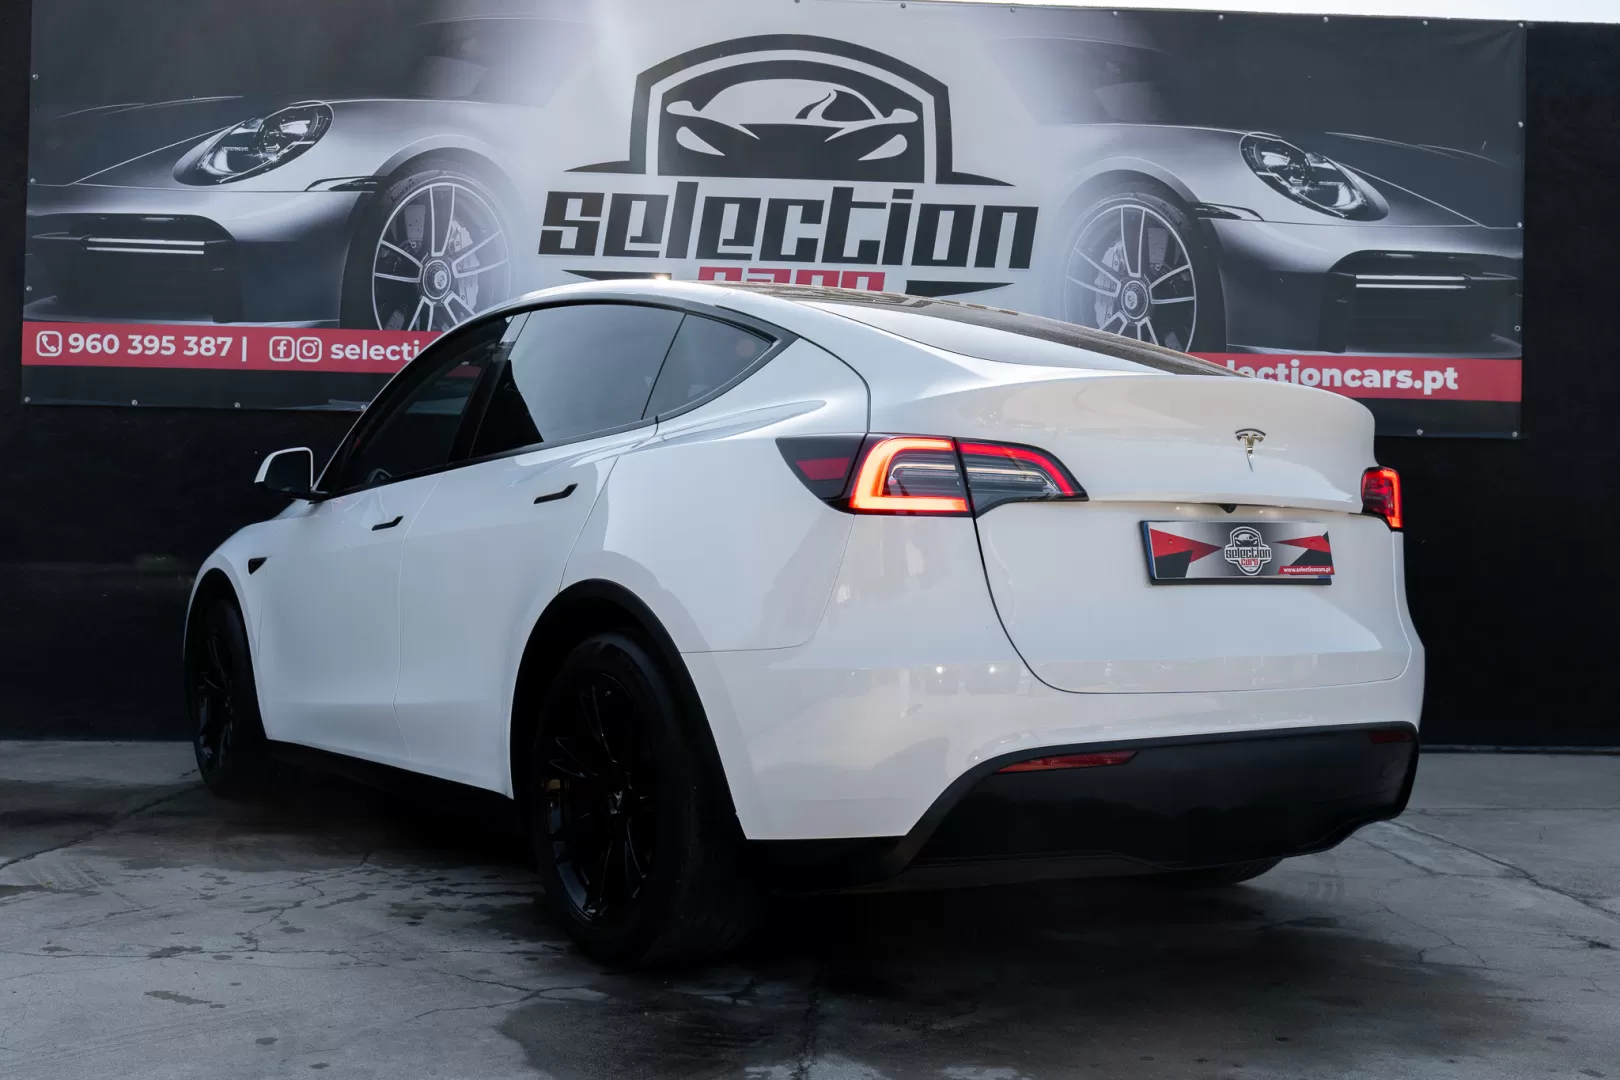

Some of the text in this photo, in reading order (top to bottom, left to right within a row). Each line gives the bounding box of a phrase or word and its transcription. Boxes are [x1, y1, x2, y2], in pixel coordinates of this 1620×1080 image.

[538, 181, 1039, 269] selection
[68, 333, 120, 354] 960
[127, 335, 176, 356] 395
[183, 336, 233, 357] 387
[330, 339, 420, 361] selecti
[1225, 548, 1271, 559] selection
